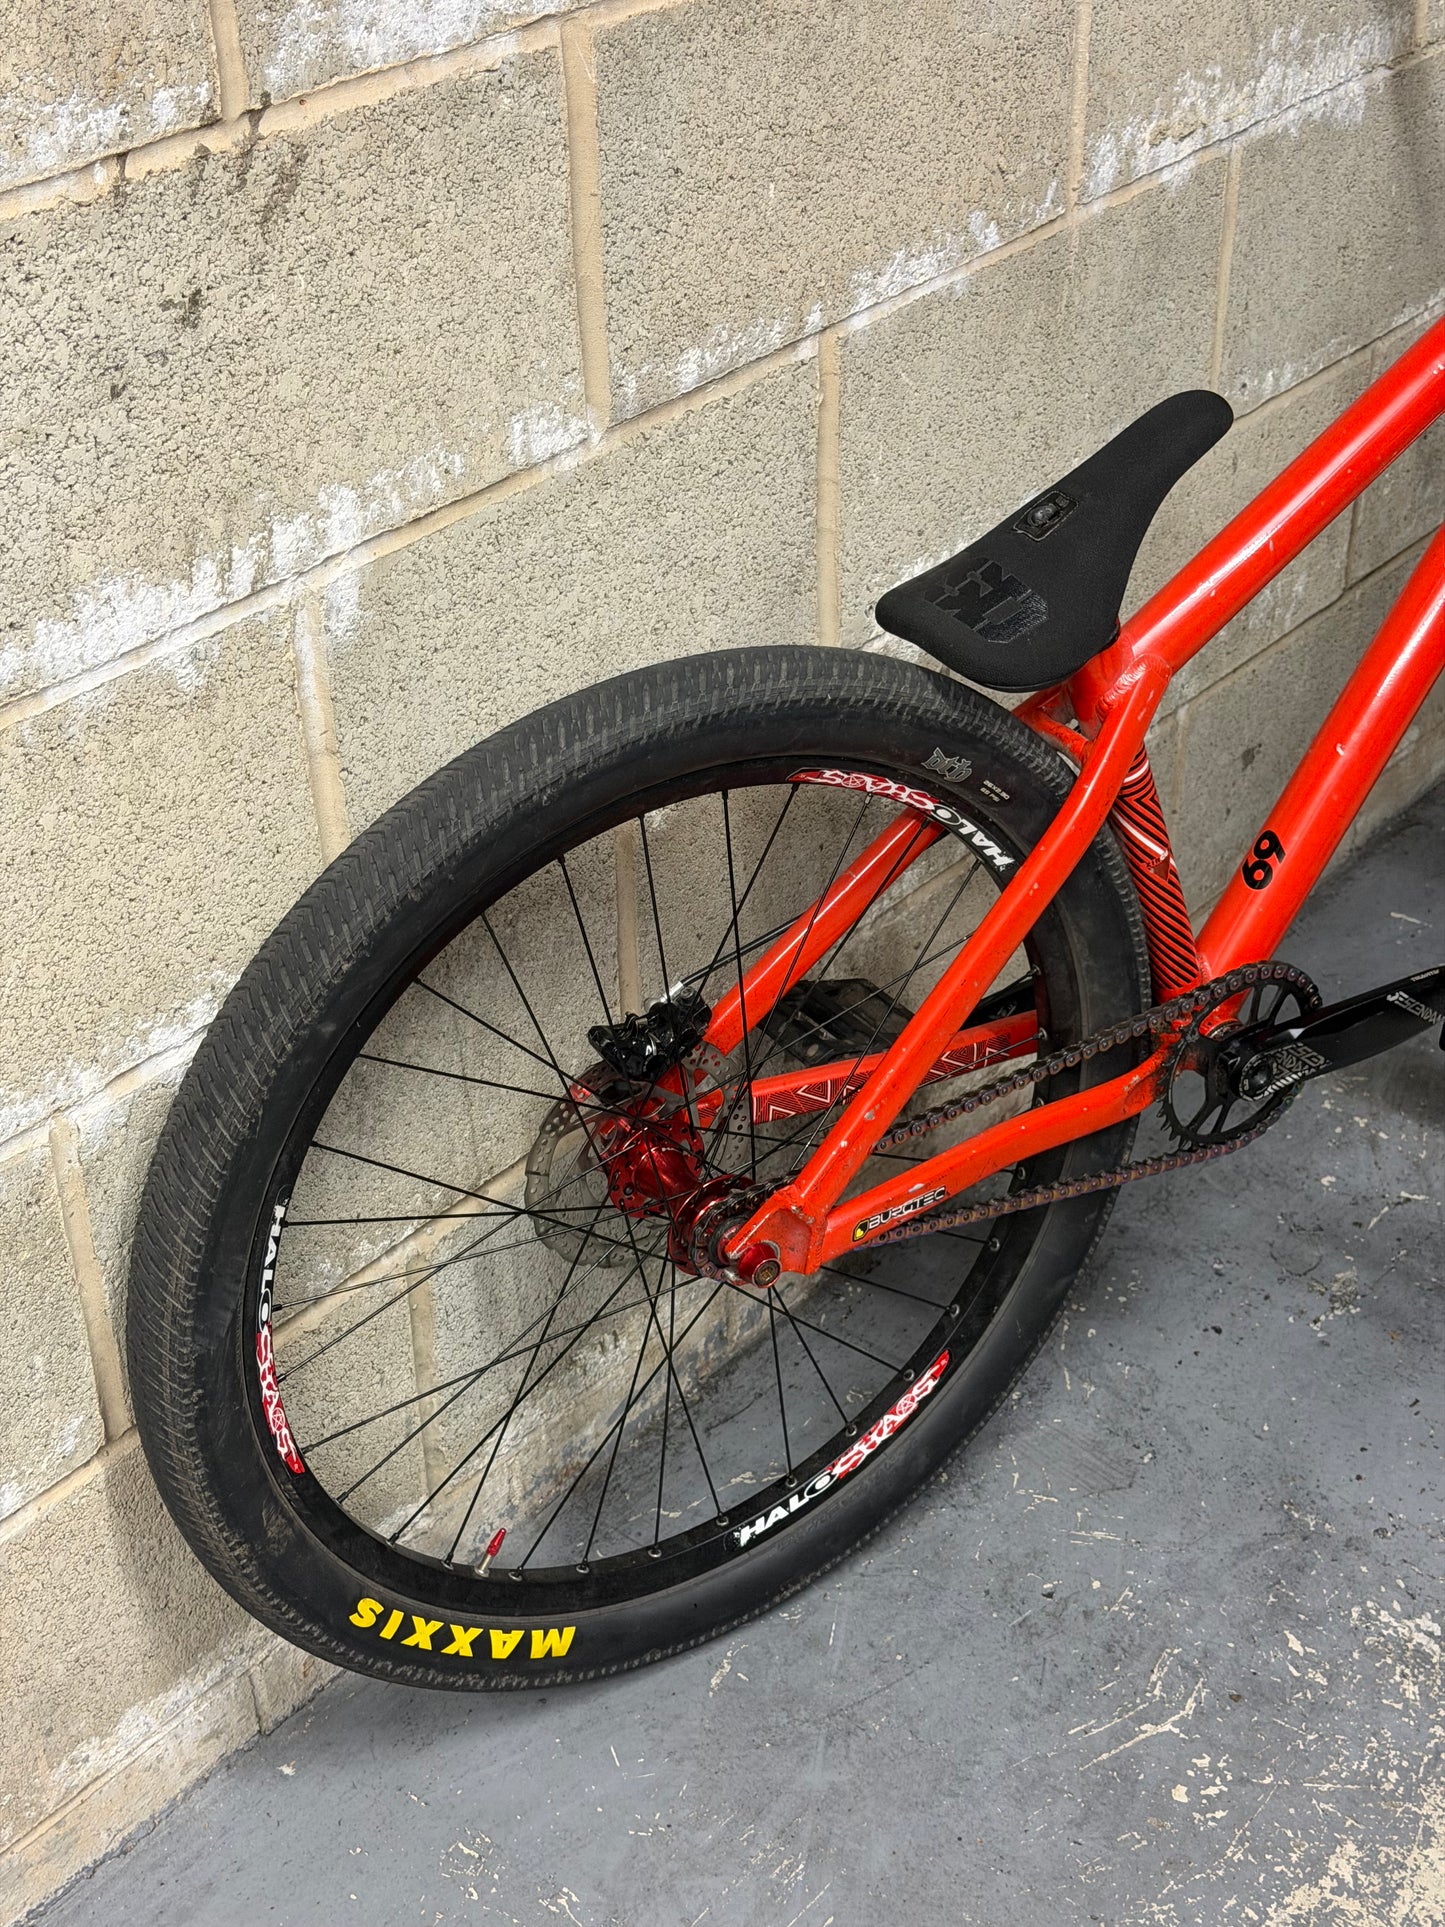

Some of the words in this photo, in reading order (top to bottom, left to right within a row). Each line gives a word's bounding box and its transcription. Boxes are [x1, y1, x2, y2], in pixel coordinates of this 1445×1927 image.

[932, 802, 1015, 870] HALO
[1241, 829, 1287, 891] 69
[258, 1200, 288, 1331] HALO
[735, 1469, 839, 1547] HALO
[348, 1597, 577, 1660] MAXXIS
